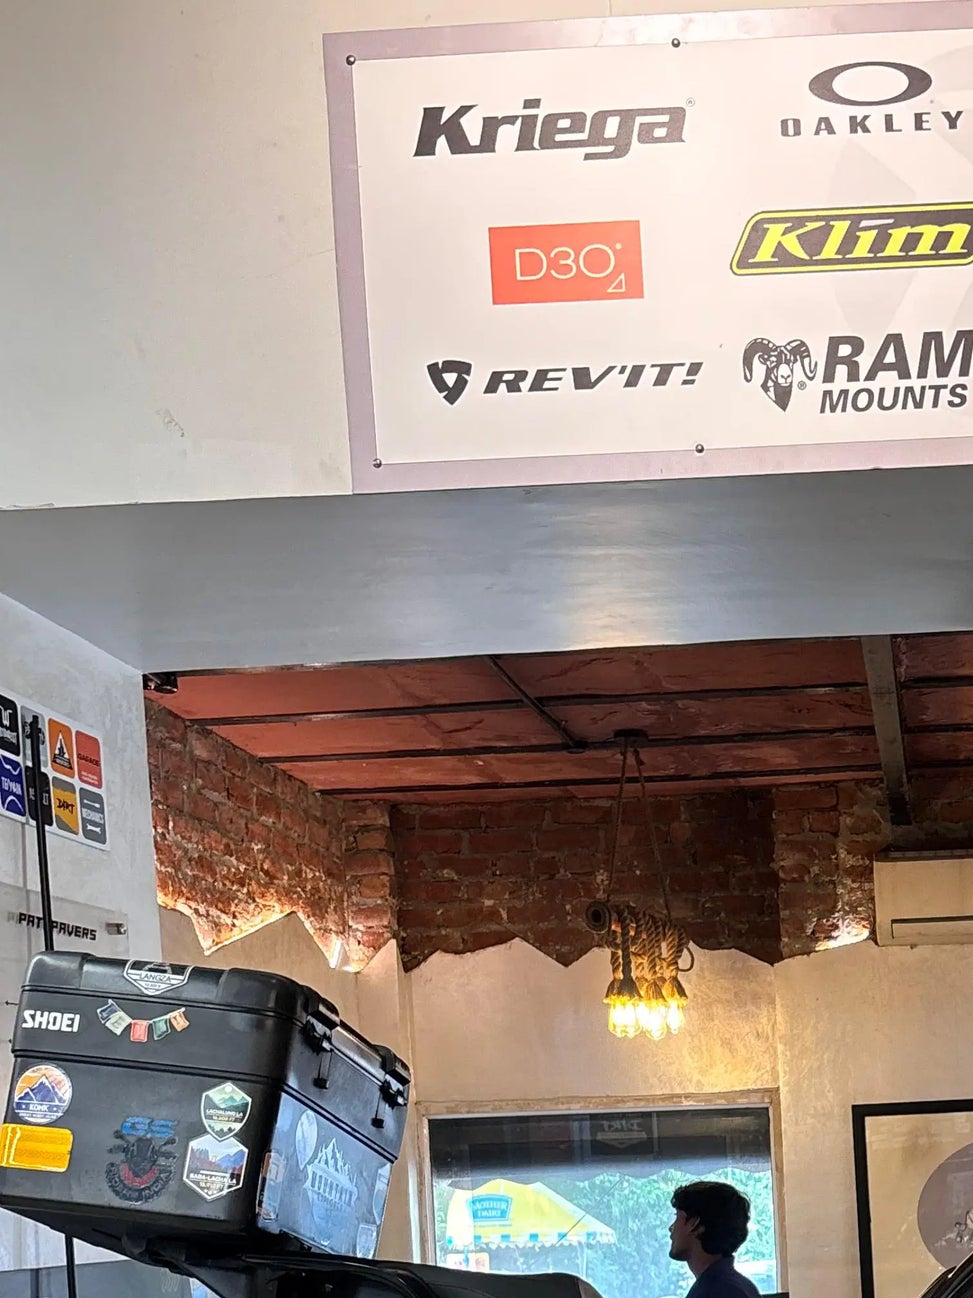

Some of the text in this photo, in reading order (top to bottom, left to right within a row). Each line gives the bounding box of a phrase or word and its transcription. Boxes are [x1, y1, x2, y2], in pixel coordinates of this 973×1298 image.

[413, 98, 687, 161] Kriega
[780, 110, 964, 138] OAKLEY
[748, 217, 973, 264] Klim
[483, 361, 705, 395] REV'IT!
[819, 384, 969, 414] MOUNTS
[18, 911, 97, 941] PATPAVERS
[22, 1009, 81, 1033] SHOEI
